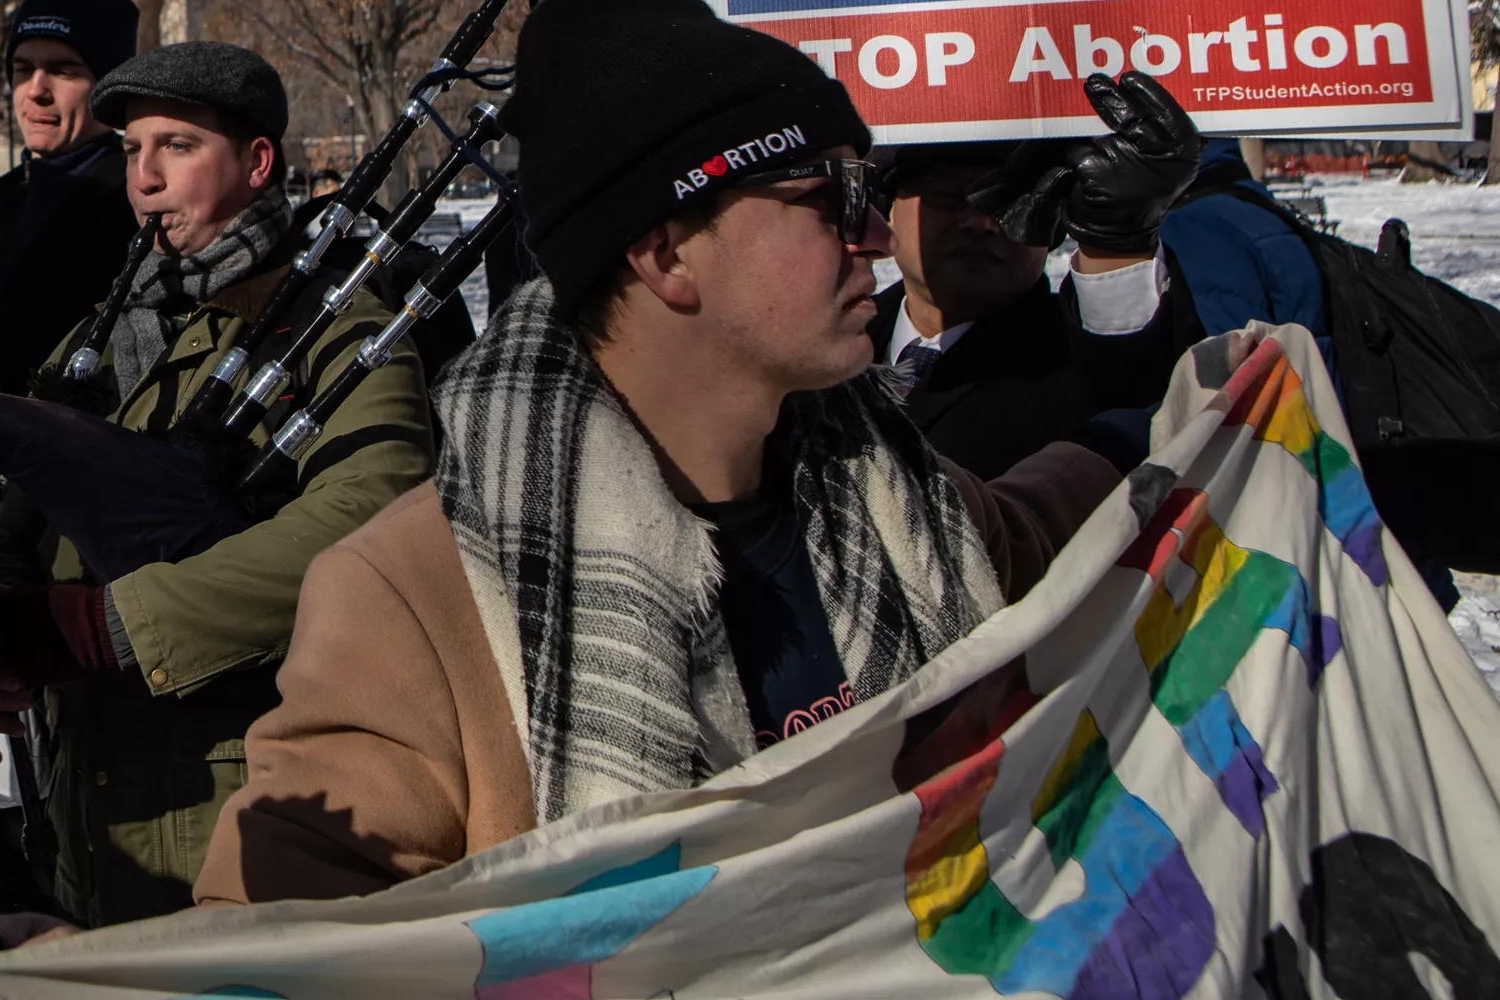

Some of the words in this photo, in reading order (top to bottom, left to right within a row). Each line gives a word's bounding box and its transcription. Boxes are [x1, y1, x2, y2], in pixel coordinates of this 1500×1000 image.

[798, 31, 976, 90] TOP
[1009, 14, 1410, 83] Abortion
[1193, 80, 1414, 102] TFPStudentAction.org
